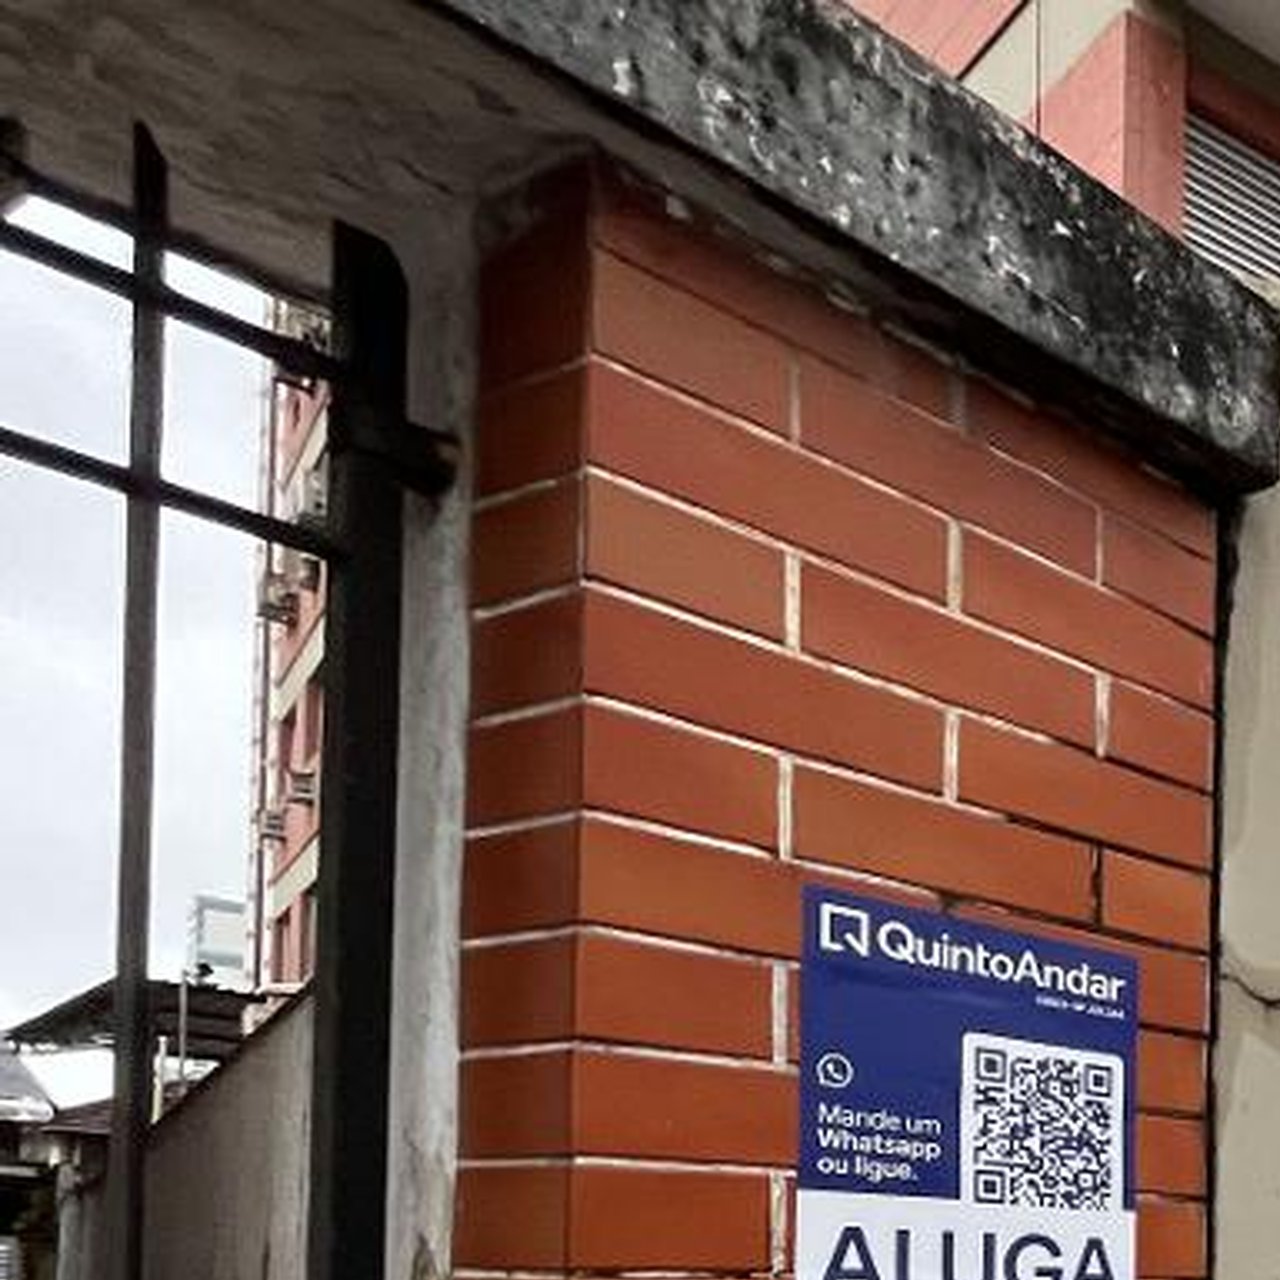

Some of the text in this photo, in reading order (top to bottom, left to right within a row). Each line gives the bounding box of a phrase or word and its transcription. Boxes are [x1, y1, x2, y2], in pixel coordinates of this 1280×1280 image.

[877, 920, 1127, 1001] QuintoAndar
[818, 1101, 941, 1135] Mande um
[817, 1127, 941, 1162] Whatsapp
[817, 1157, 848, 1174] ou
